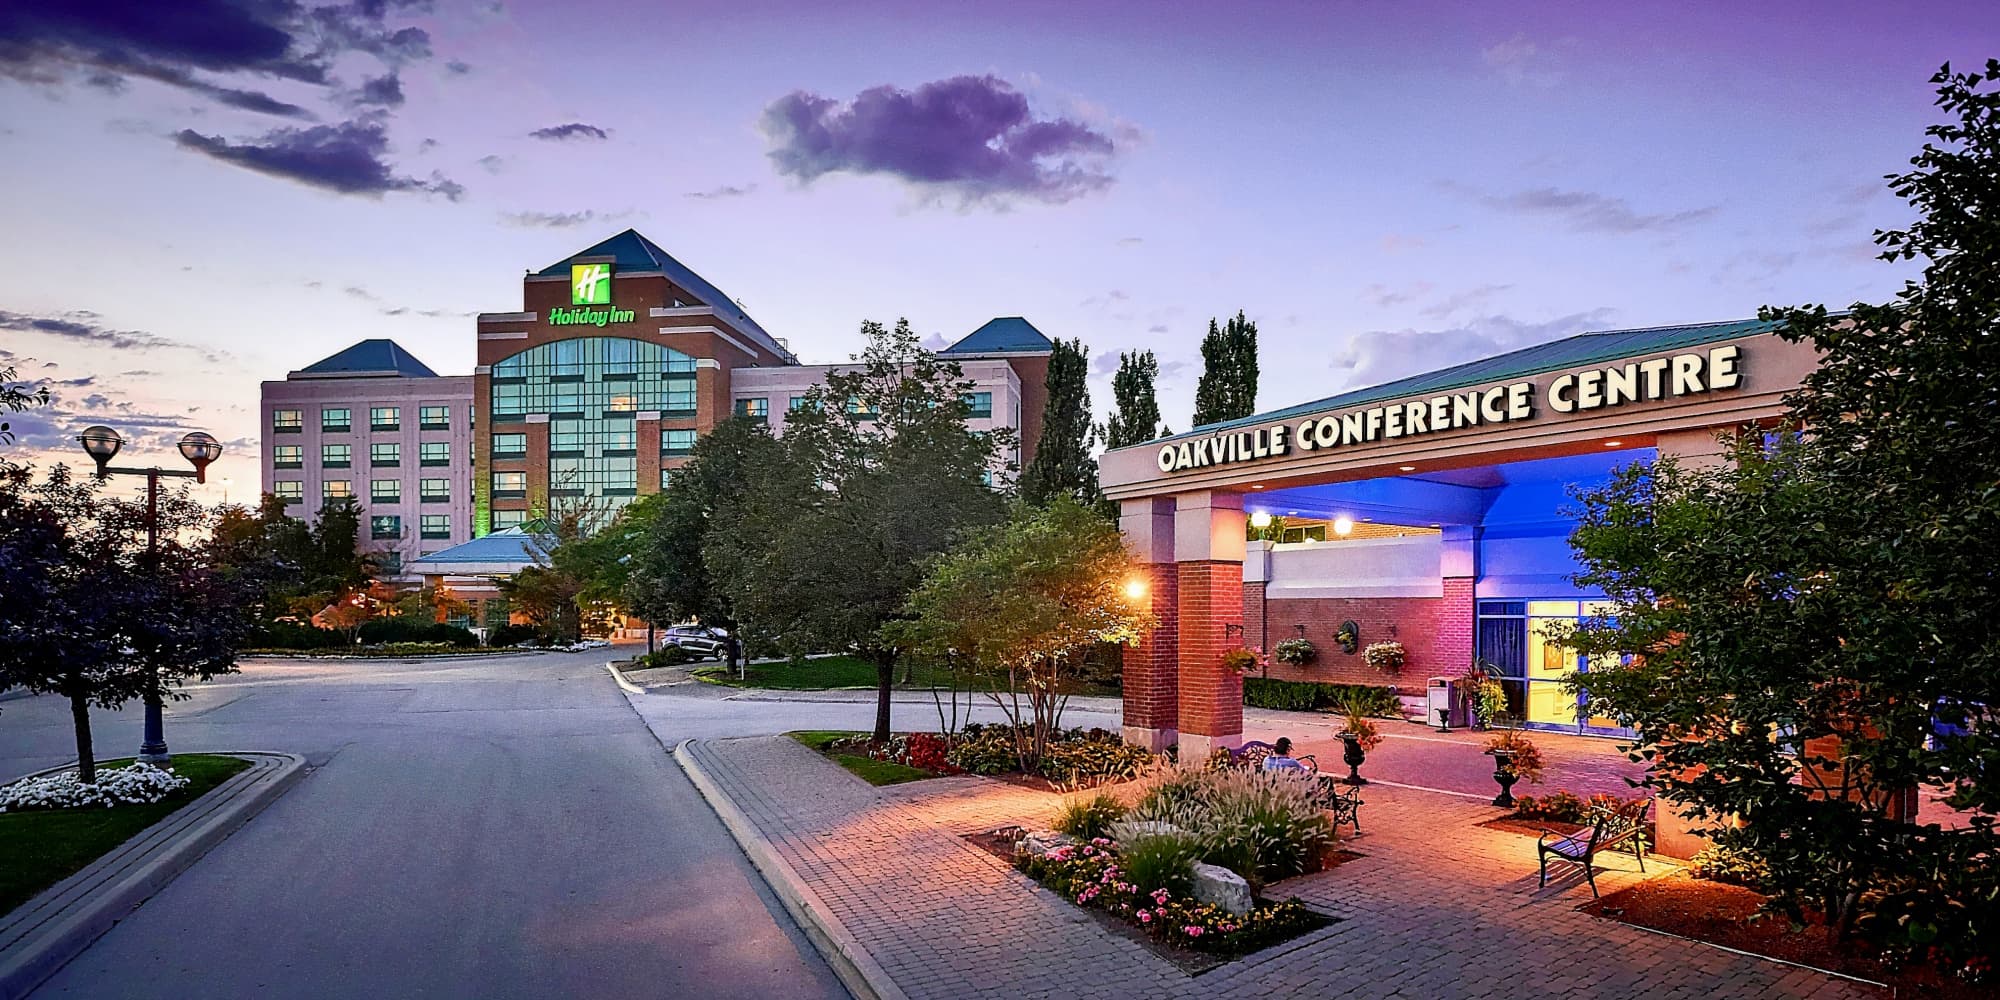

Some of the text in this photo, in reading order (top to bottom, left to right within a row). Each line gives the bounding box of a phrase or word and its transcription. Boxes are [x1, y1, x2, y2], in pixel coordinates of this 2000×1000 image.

[548, 305, 635, 327] Holiday Inn
[1157, 345, 1740, 473] OAKVILLE CONFERENCE CENTRE
